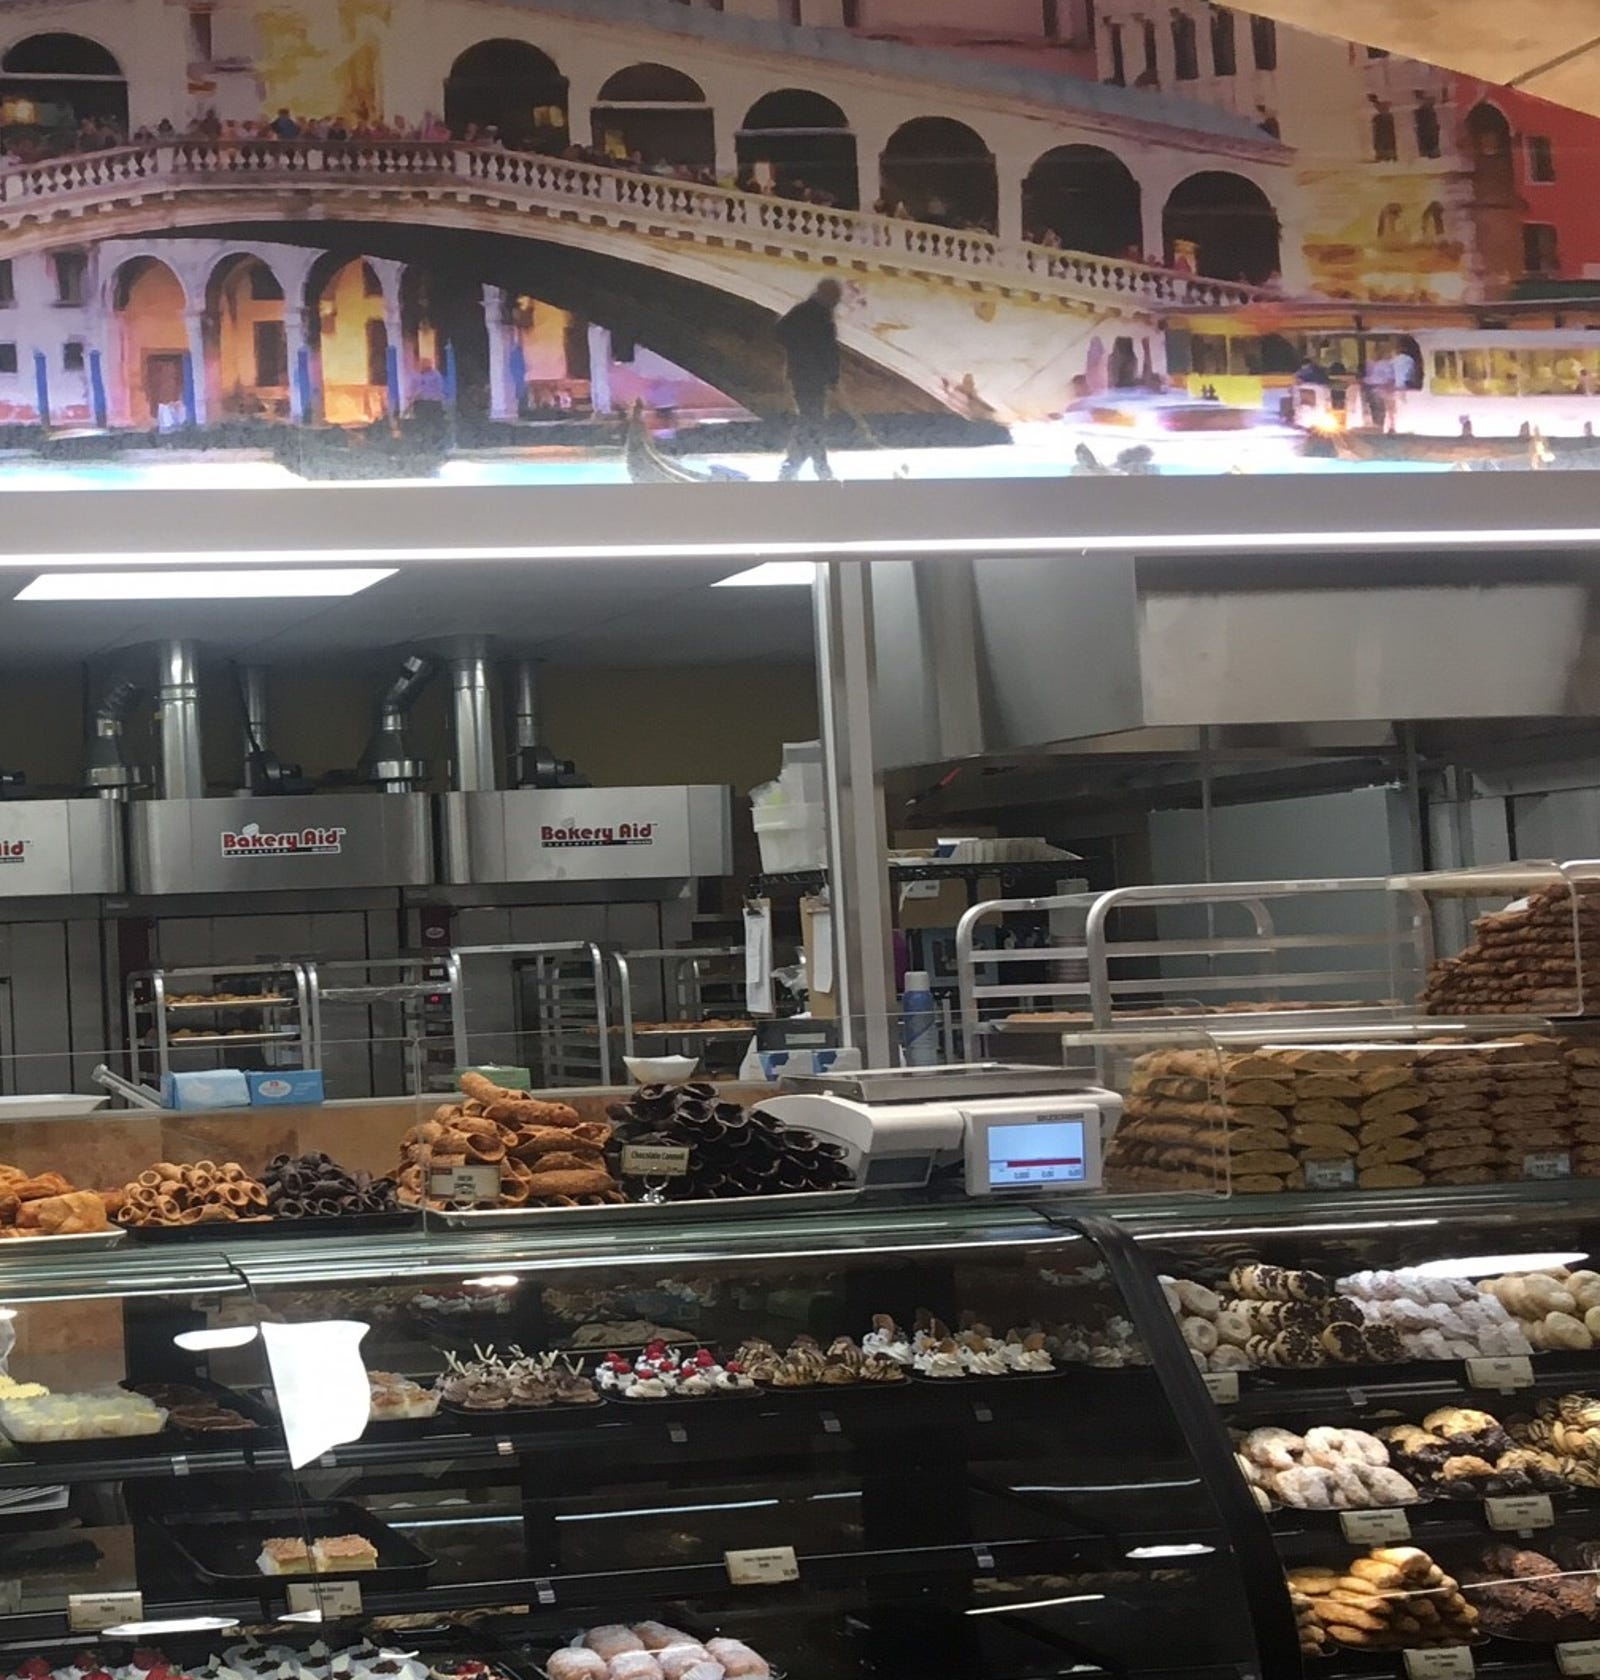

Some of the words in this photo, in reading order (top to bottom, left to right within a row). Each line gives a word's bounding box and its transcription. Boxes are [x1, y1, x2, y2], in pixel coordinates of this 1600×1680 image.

[224, 833, 298, 852] Bakery
[304, 829, 337, 845] Aid
[541, 826, 613, 845] Bakery
[619, 823, 651, 838] Aid
[631, 1151, 661, 1159] Chocolate
